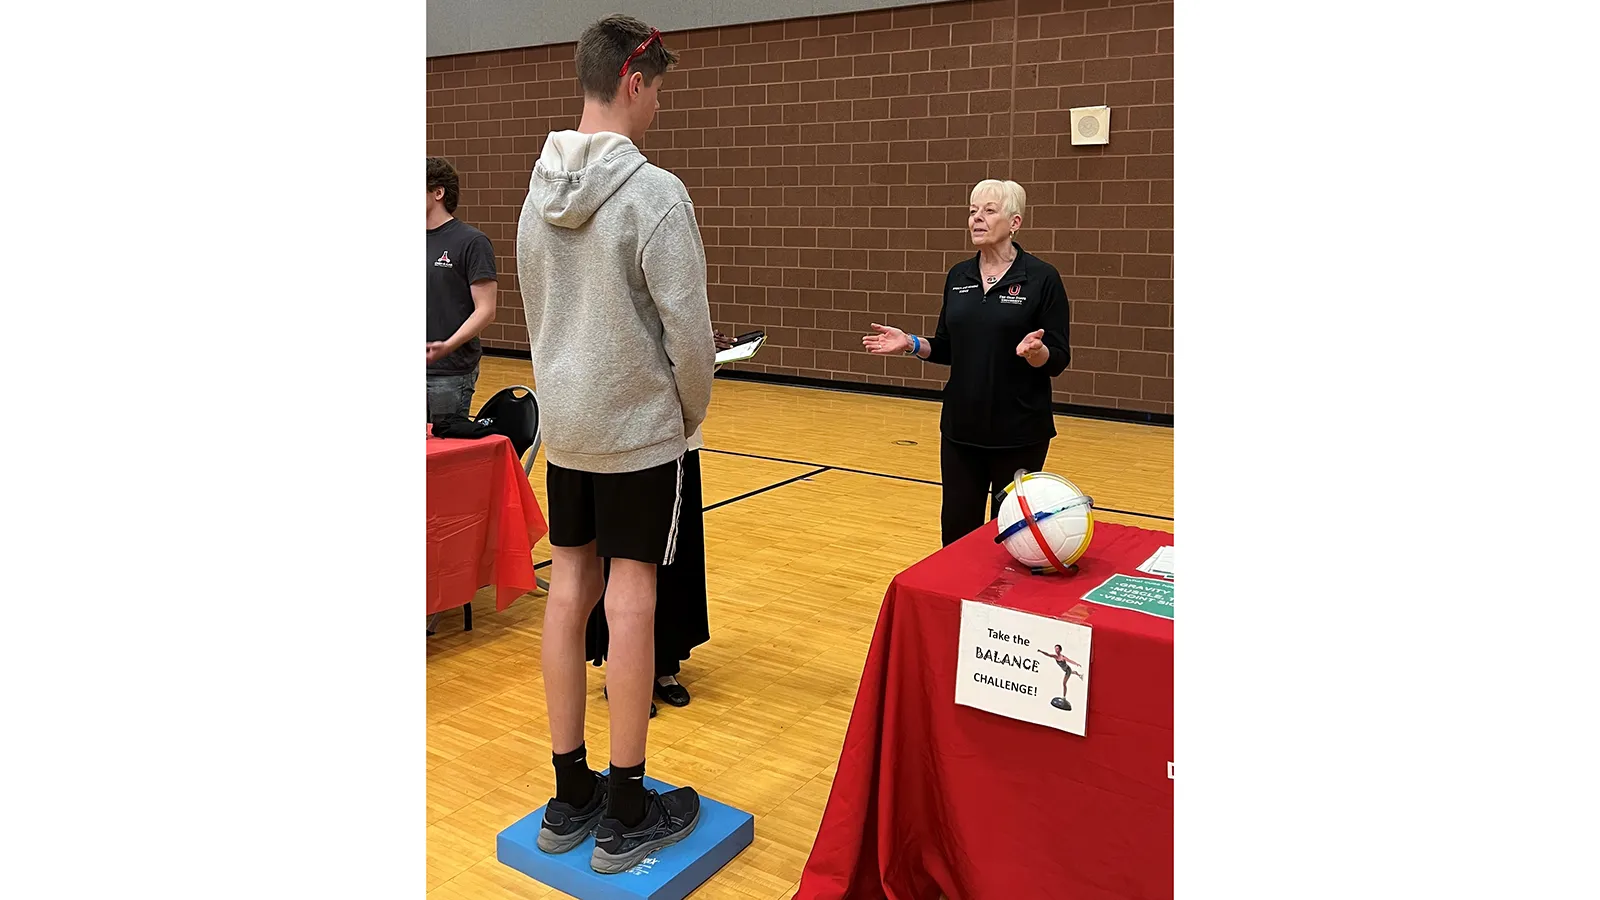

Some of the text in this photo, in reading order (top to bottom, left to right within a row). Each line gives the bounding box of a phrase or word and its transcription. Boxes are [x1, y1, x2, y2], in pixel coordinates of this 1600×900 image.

[1114, 587, 1165, 600] MUSCLE,
[1120, 583, 1171, 594] GRAVITY
[1105, 594, 1144, 605] VISION
[1120, 594, 1156, 602] JOINT
[987, 628, 1030, 646] Take the
[975, 646, 1040, 673] BALANCE
[973, 673, 1038, 696] CHALLENGE!
